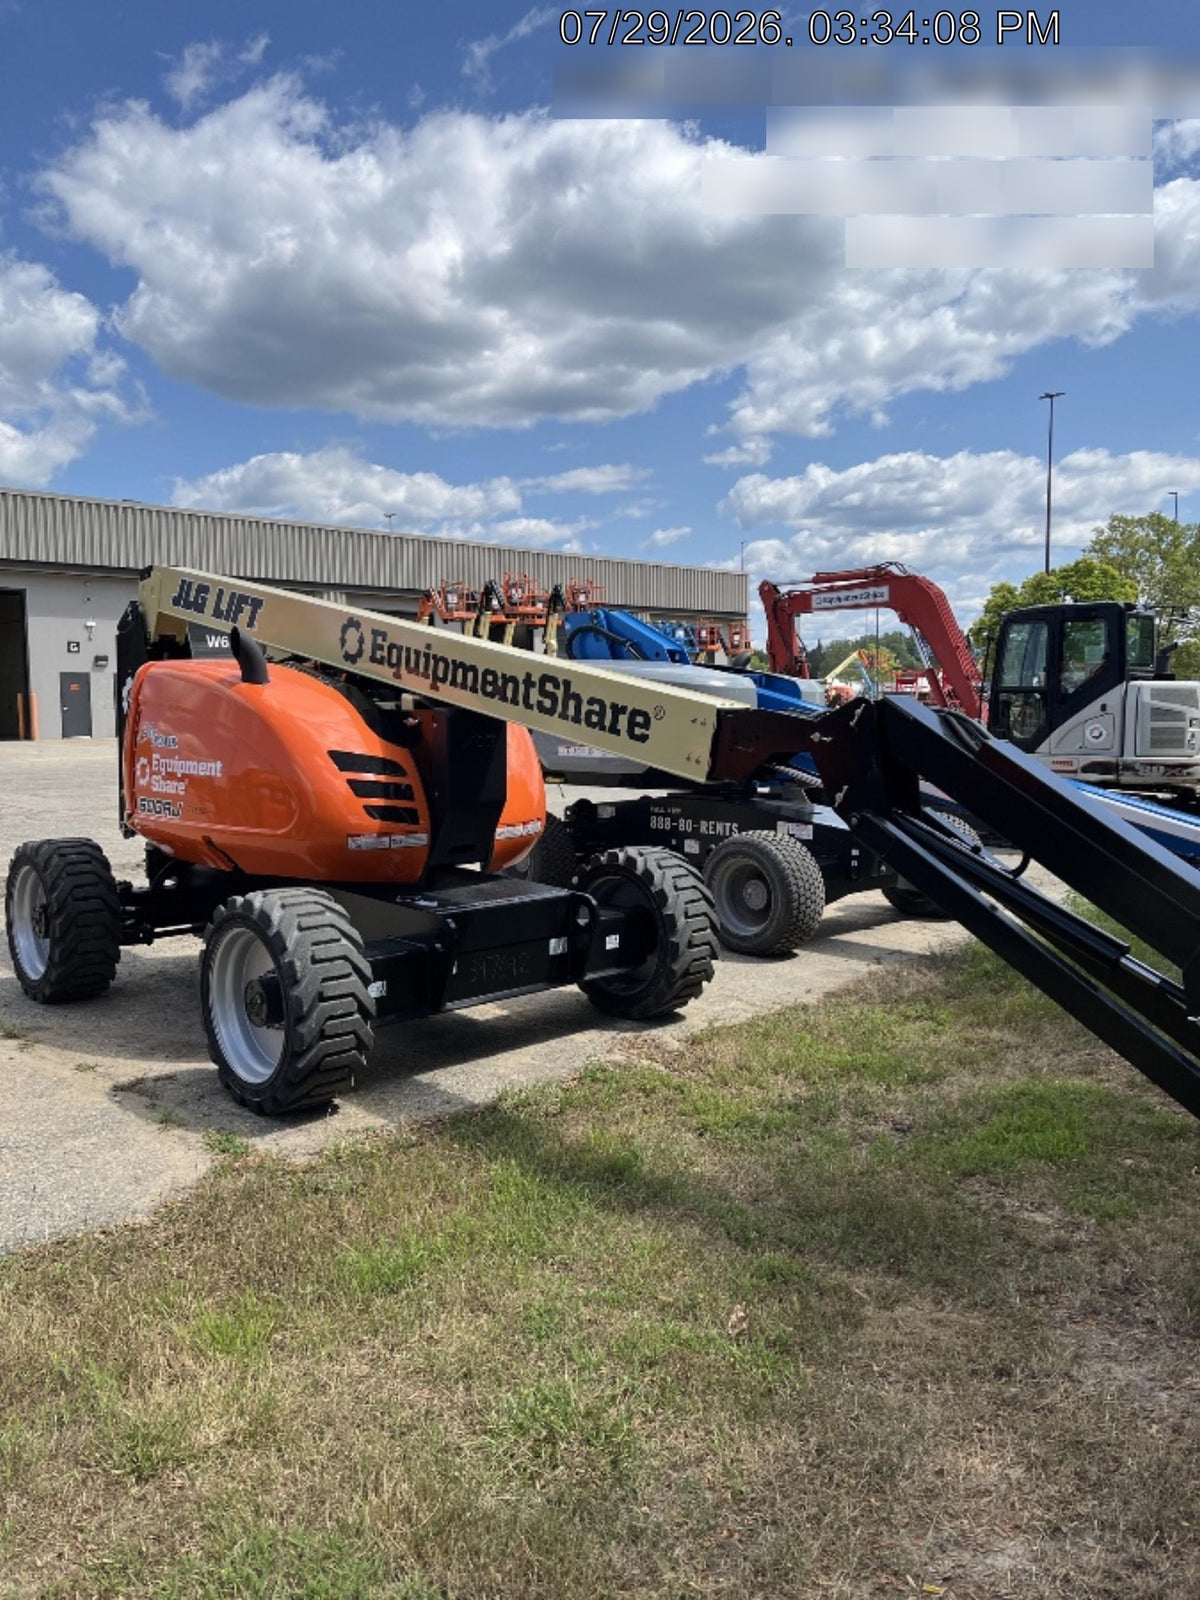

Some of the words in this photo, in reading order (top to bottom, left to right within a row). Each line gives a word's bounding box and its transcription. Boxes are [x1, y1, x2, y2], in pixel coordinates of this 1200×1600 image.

[171, 578, 211, 614] JLG
[211, 587, 265, 630] LIFT
[152, 753, 223, 778] Equipment
[151, 774, 186, 796] Share
[650, 815, 739, 836] 888-80-RENTS
